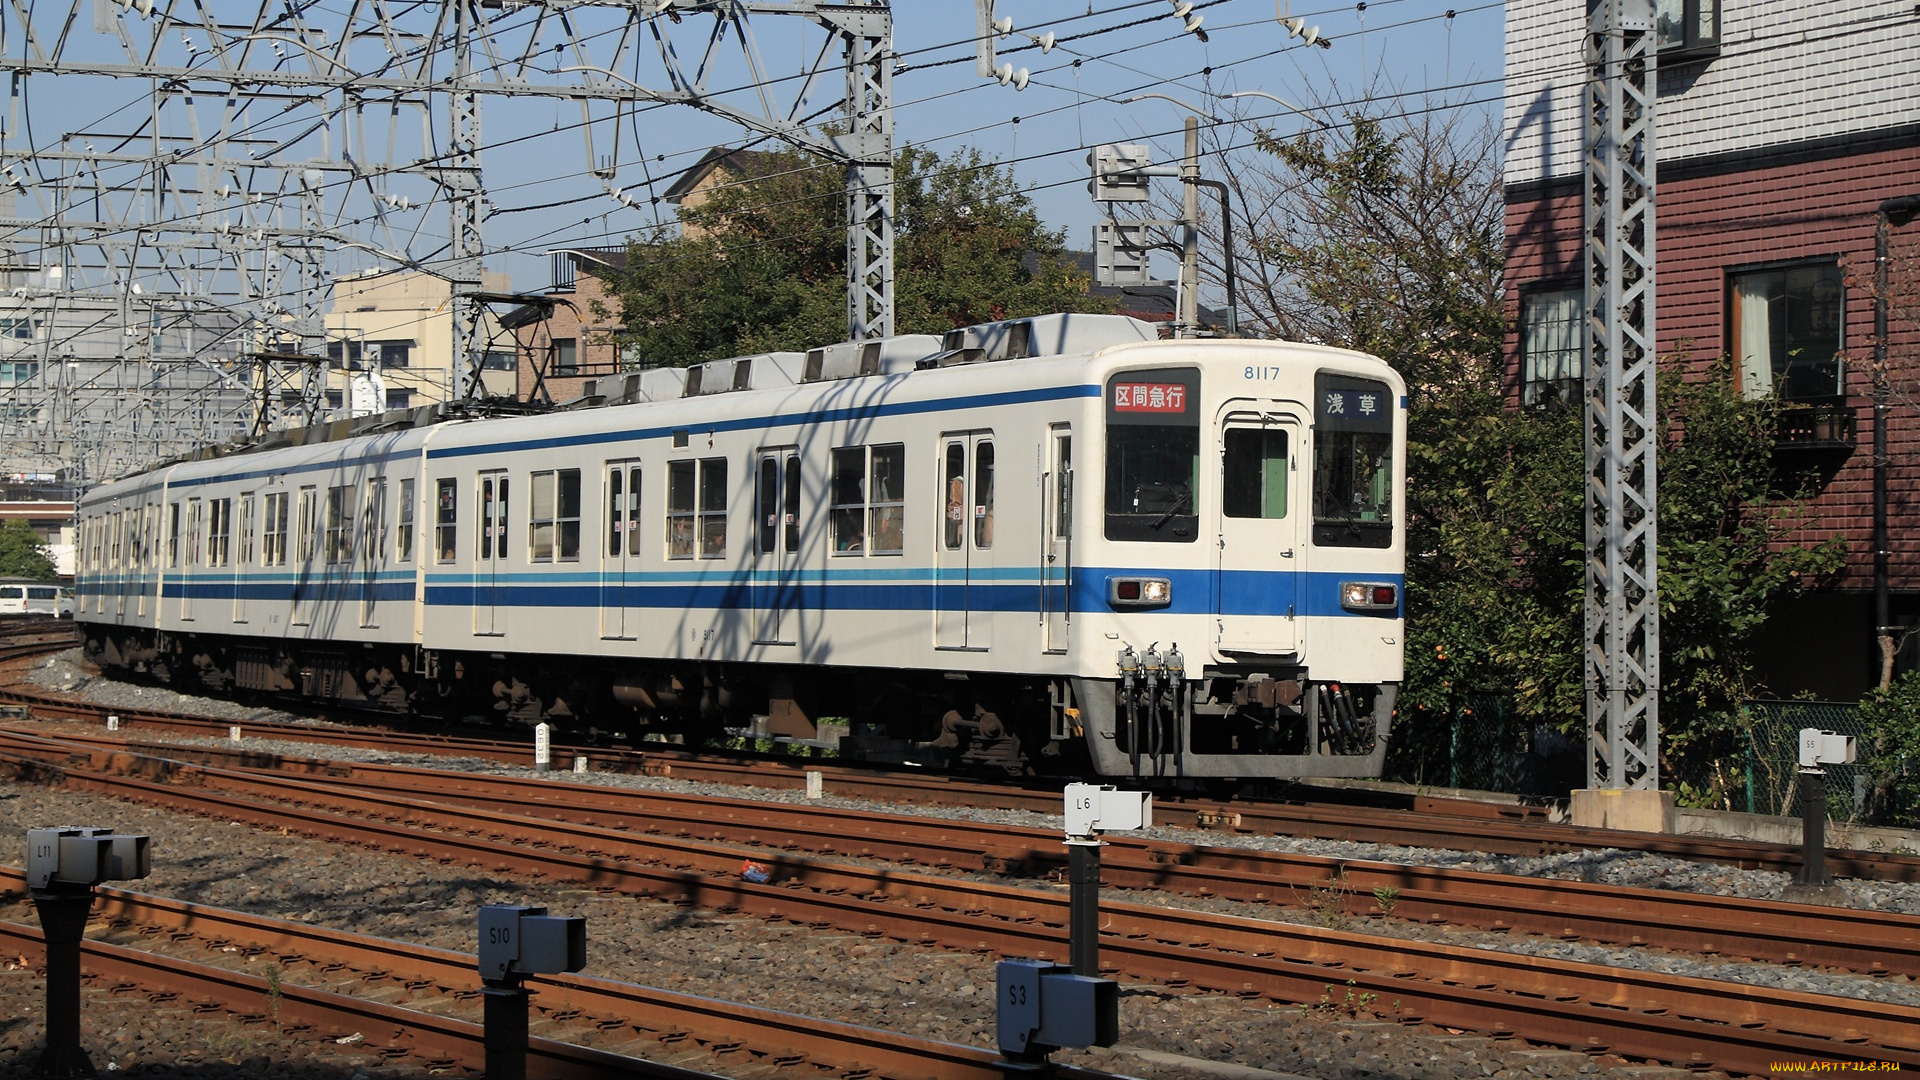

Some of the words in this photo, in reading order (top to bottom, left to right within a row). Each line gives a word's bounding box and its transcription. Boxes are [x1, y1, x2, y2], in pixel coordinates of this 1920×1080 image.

[1244, 366, 1280, 380] 8117
[1115, 385, 1183, 408] 区間急行
[1326, 393, 1376, 416] 浅草
[37, 845, 51, 858] L11
[489, 927, 511, 944] S10
[1009, 984, 1027, 1005] S3
